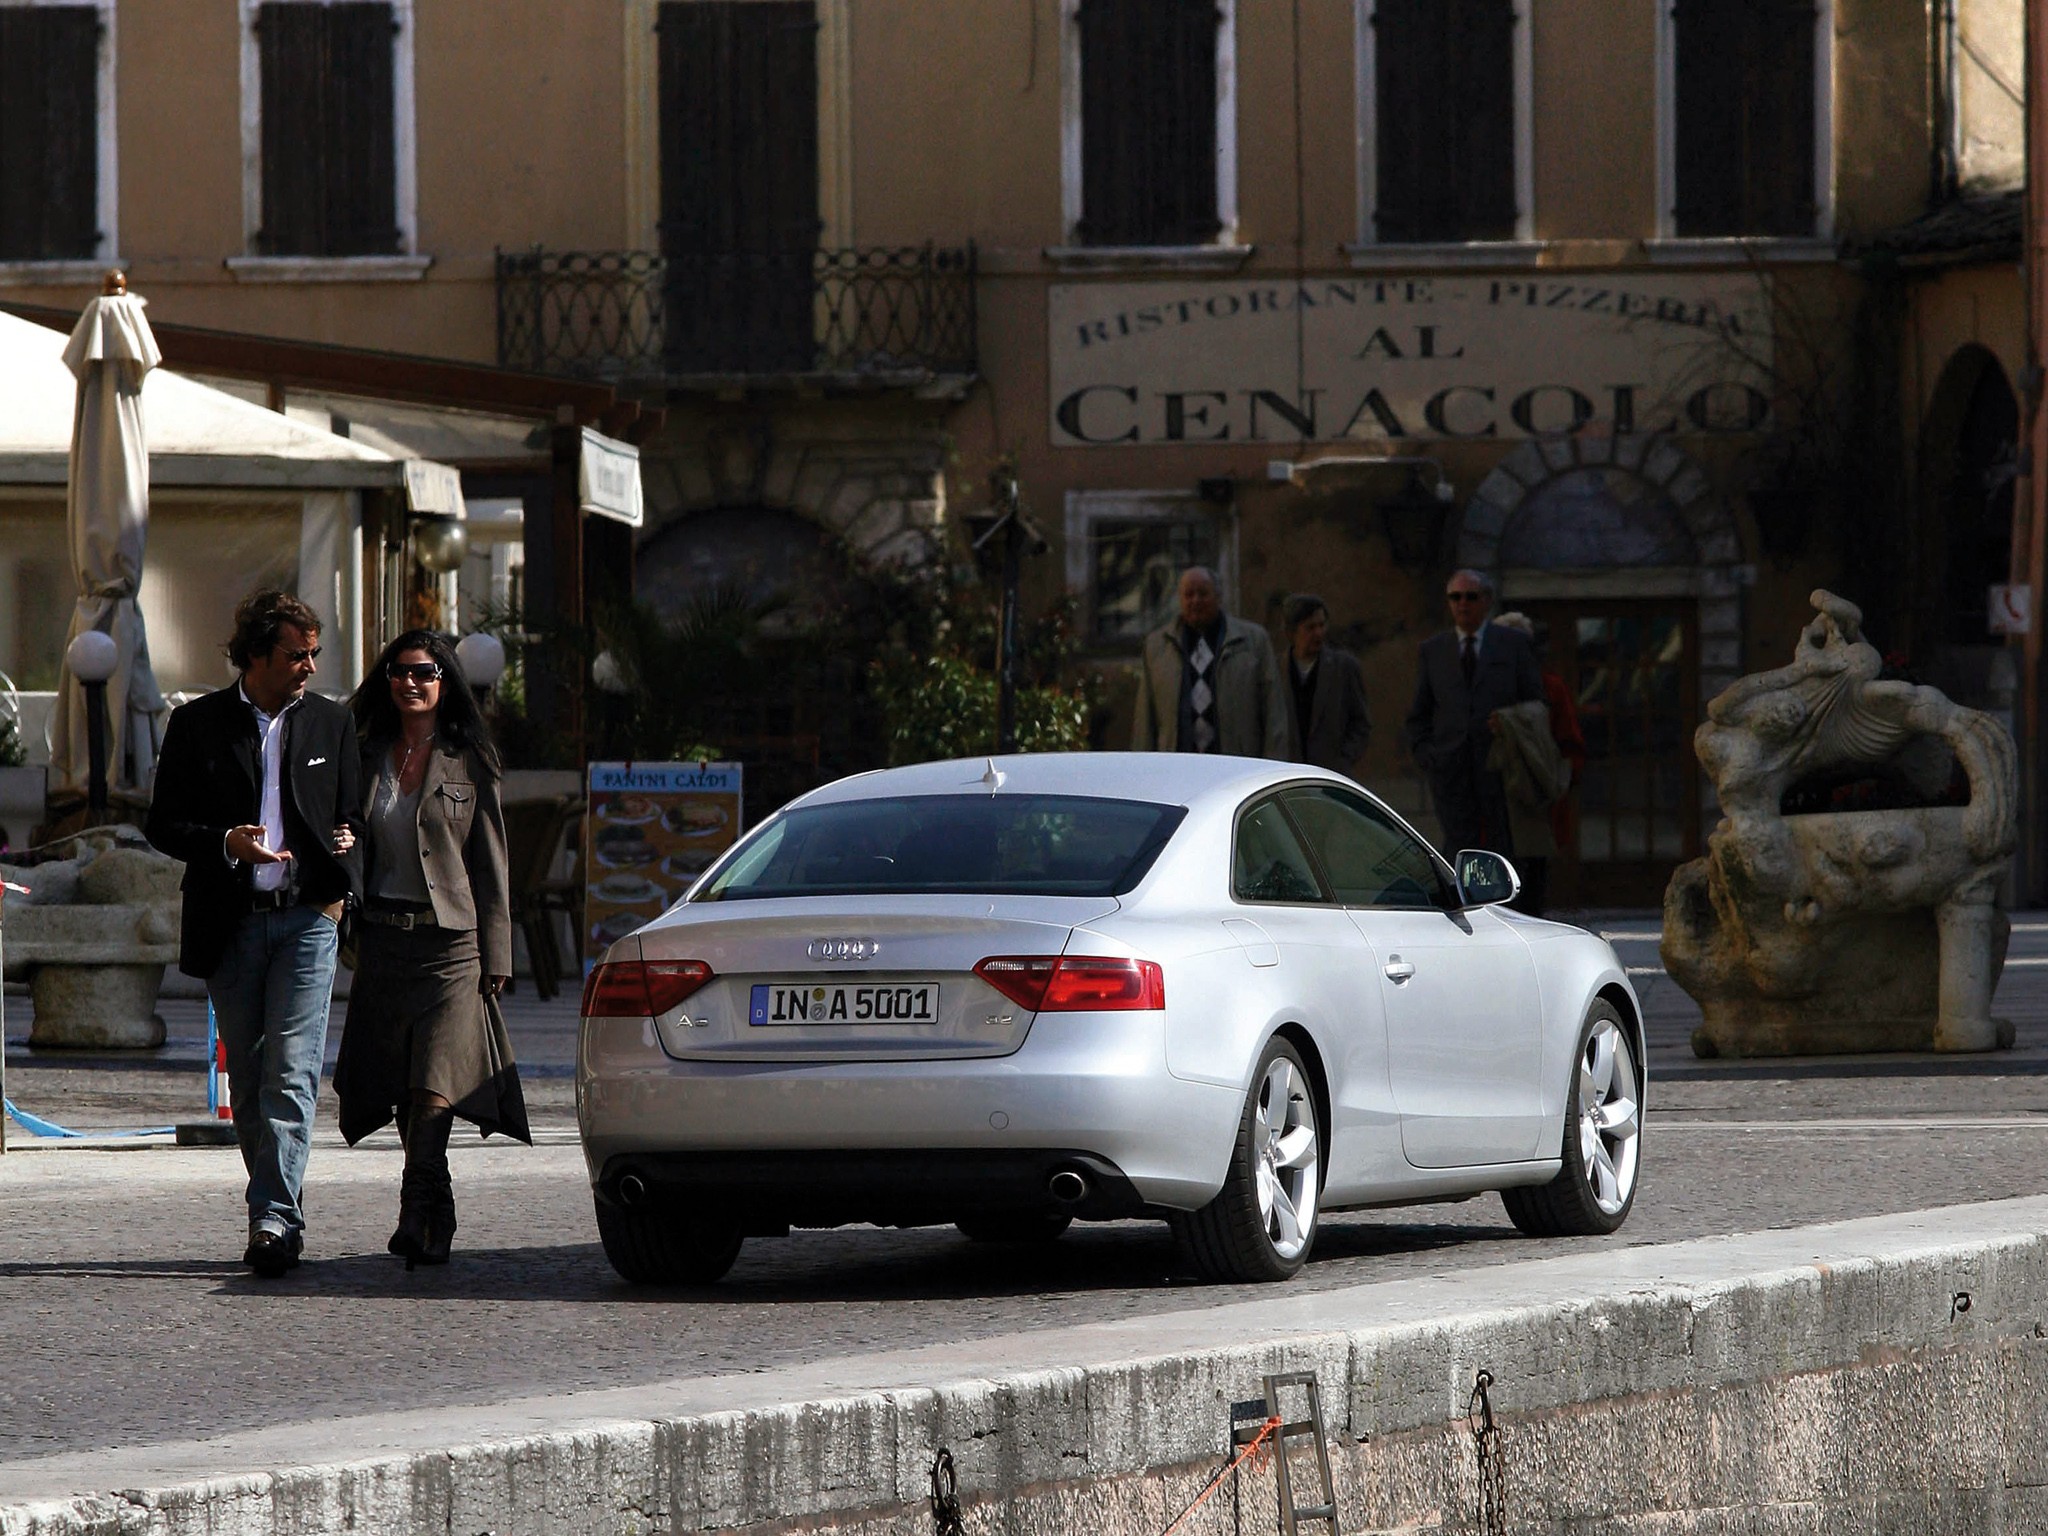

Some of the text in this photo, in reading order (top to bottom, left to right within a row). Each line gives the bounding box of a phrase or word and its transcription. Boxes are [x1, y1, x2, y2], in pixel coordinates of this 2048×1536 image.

[1076, 280, 1432, 348] RISTORANTE
[1487, 280, 1746, 335] PIZZERIA
[1353, 325, 1465, 359] AL
[1055, 384, 1770, 442] CENACOLO
[602, 772, 728, 787] PANINI CALDI
[756, 989, 931, 1020] D IN A 5001
